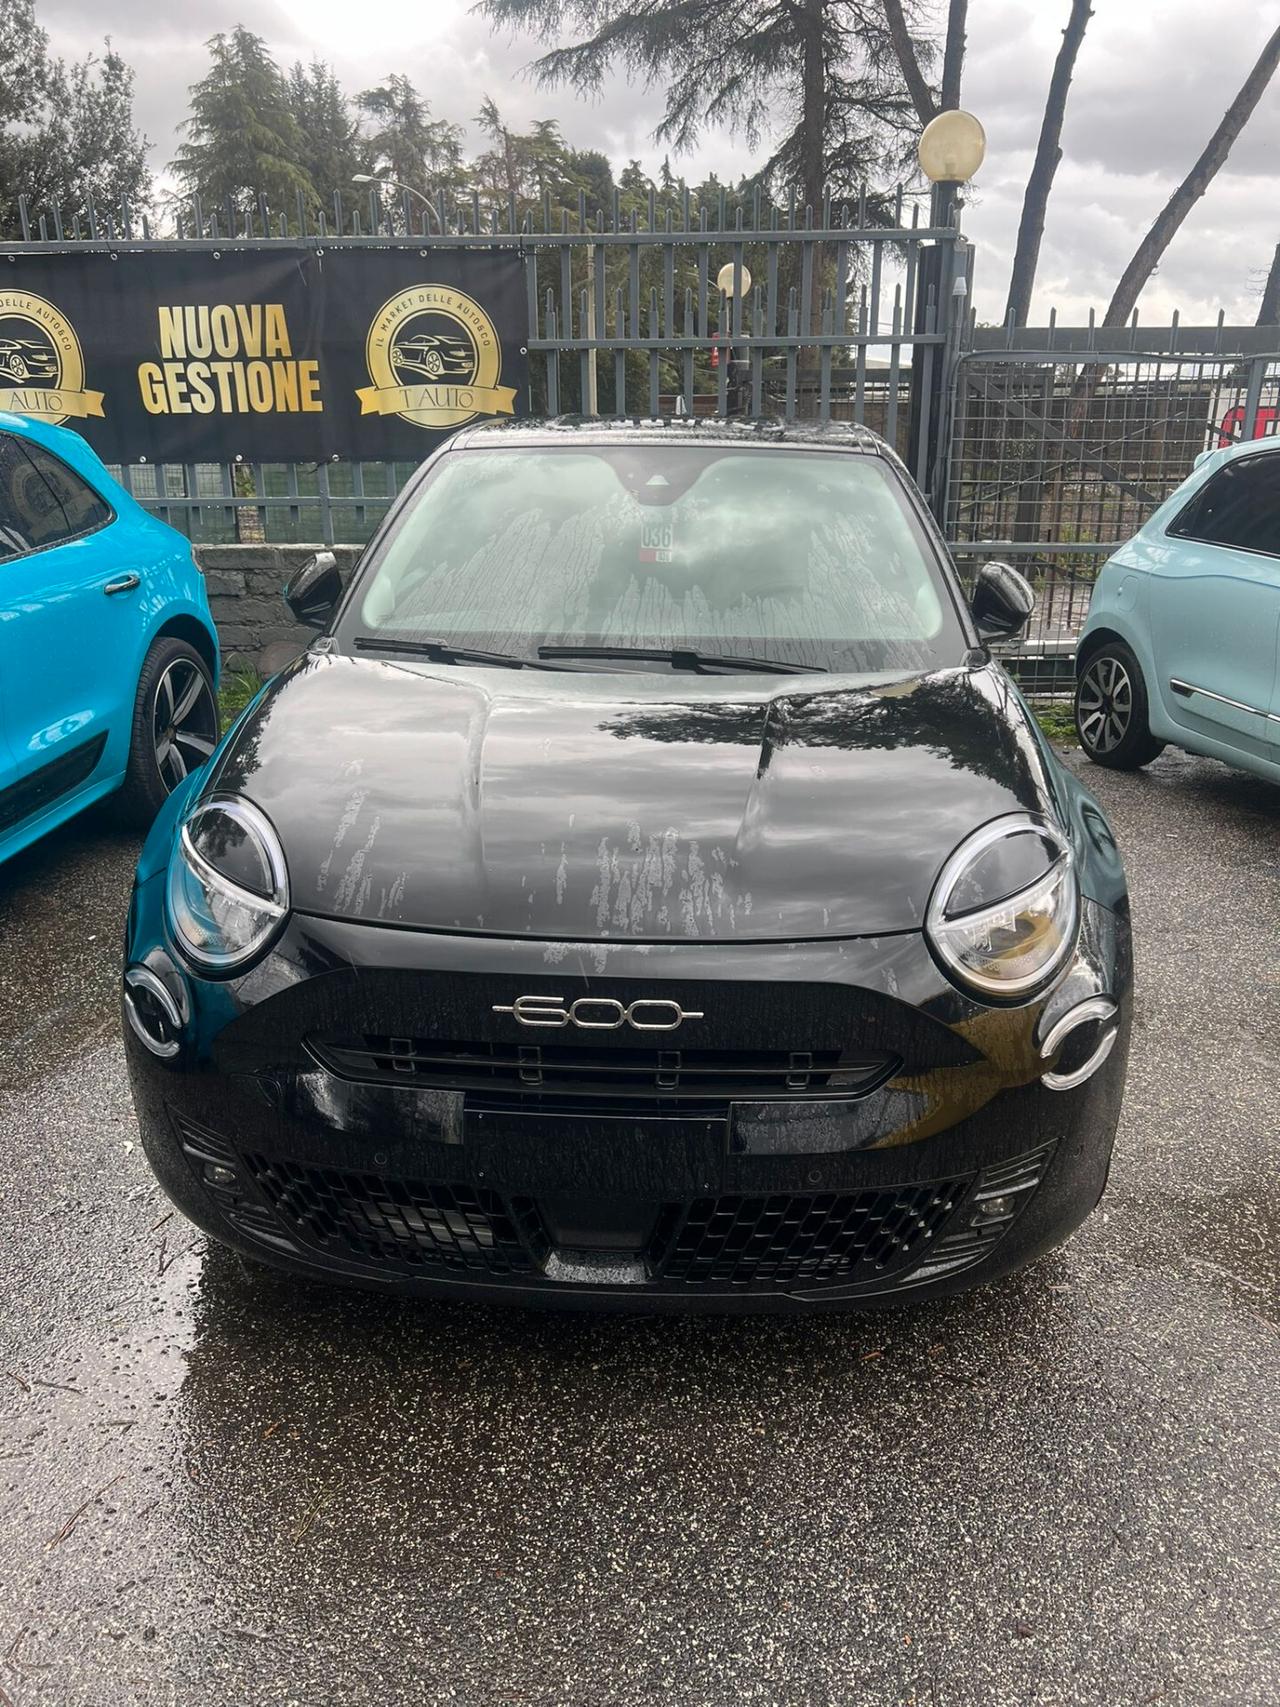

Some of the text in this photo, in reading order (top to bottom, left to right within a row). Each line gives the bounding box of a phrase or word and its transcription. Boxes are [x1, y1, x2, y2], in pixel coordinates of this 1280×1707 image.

[36, 307, 72, 351] AUTO&CO
[158, 304, 293, 359] NUOVA
[376, 293, 491, 348] IL MARKET DELLE AUTO&CO
[9, 391, 63, 411] AUTO
[137, 360, 324, 414] GESTIONE
[400, 387, 475, 409] T AUTO
[513, 995, 683, 1031] 600
